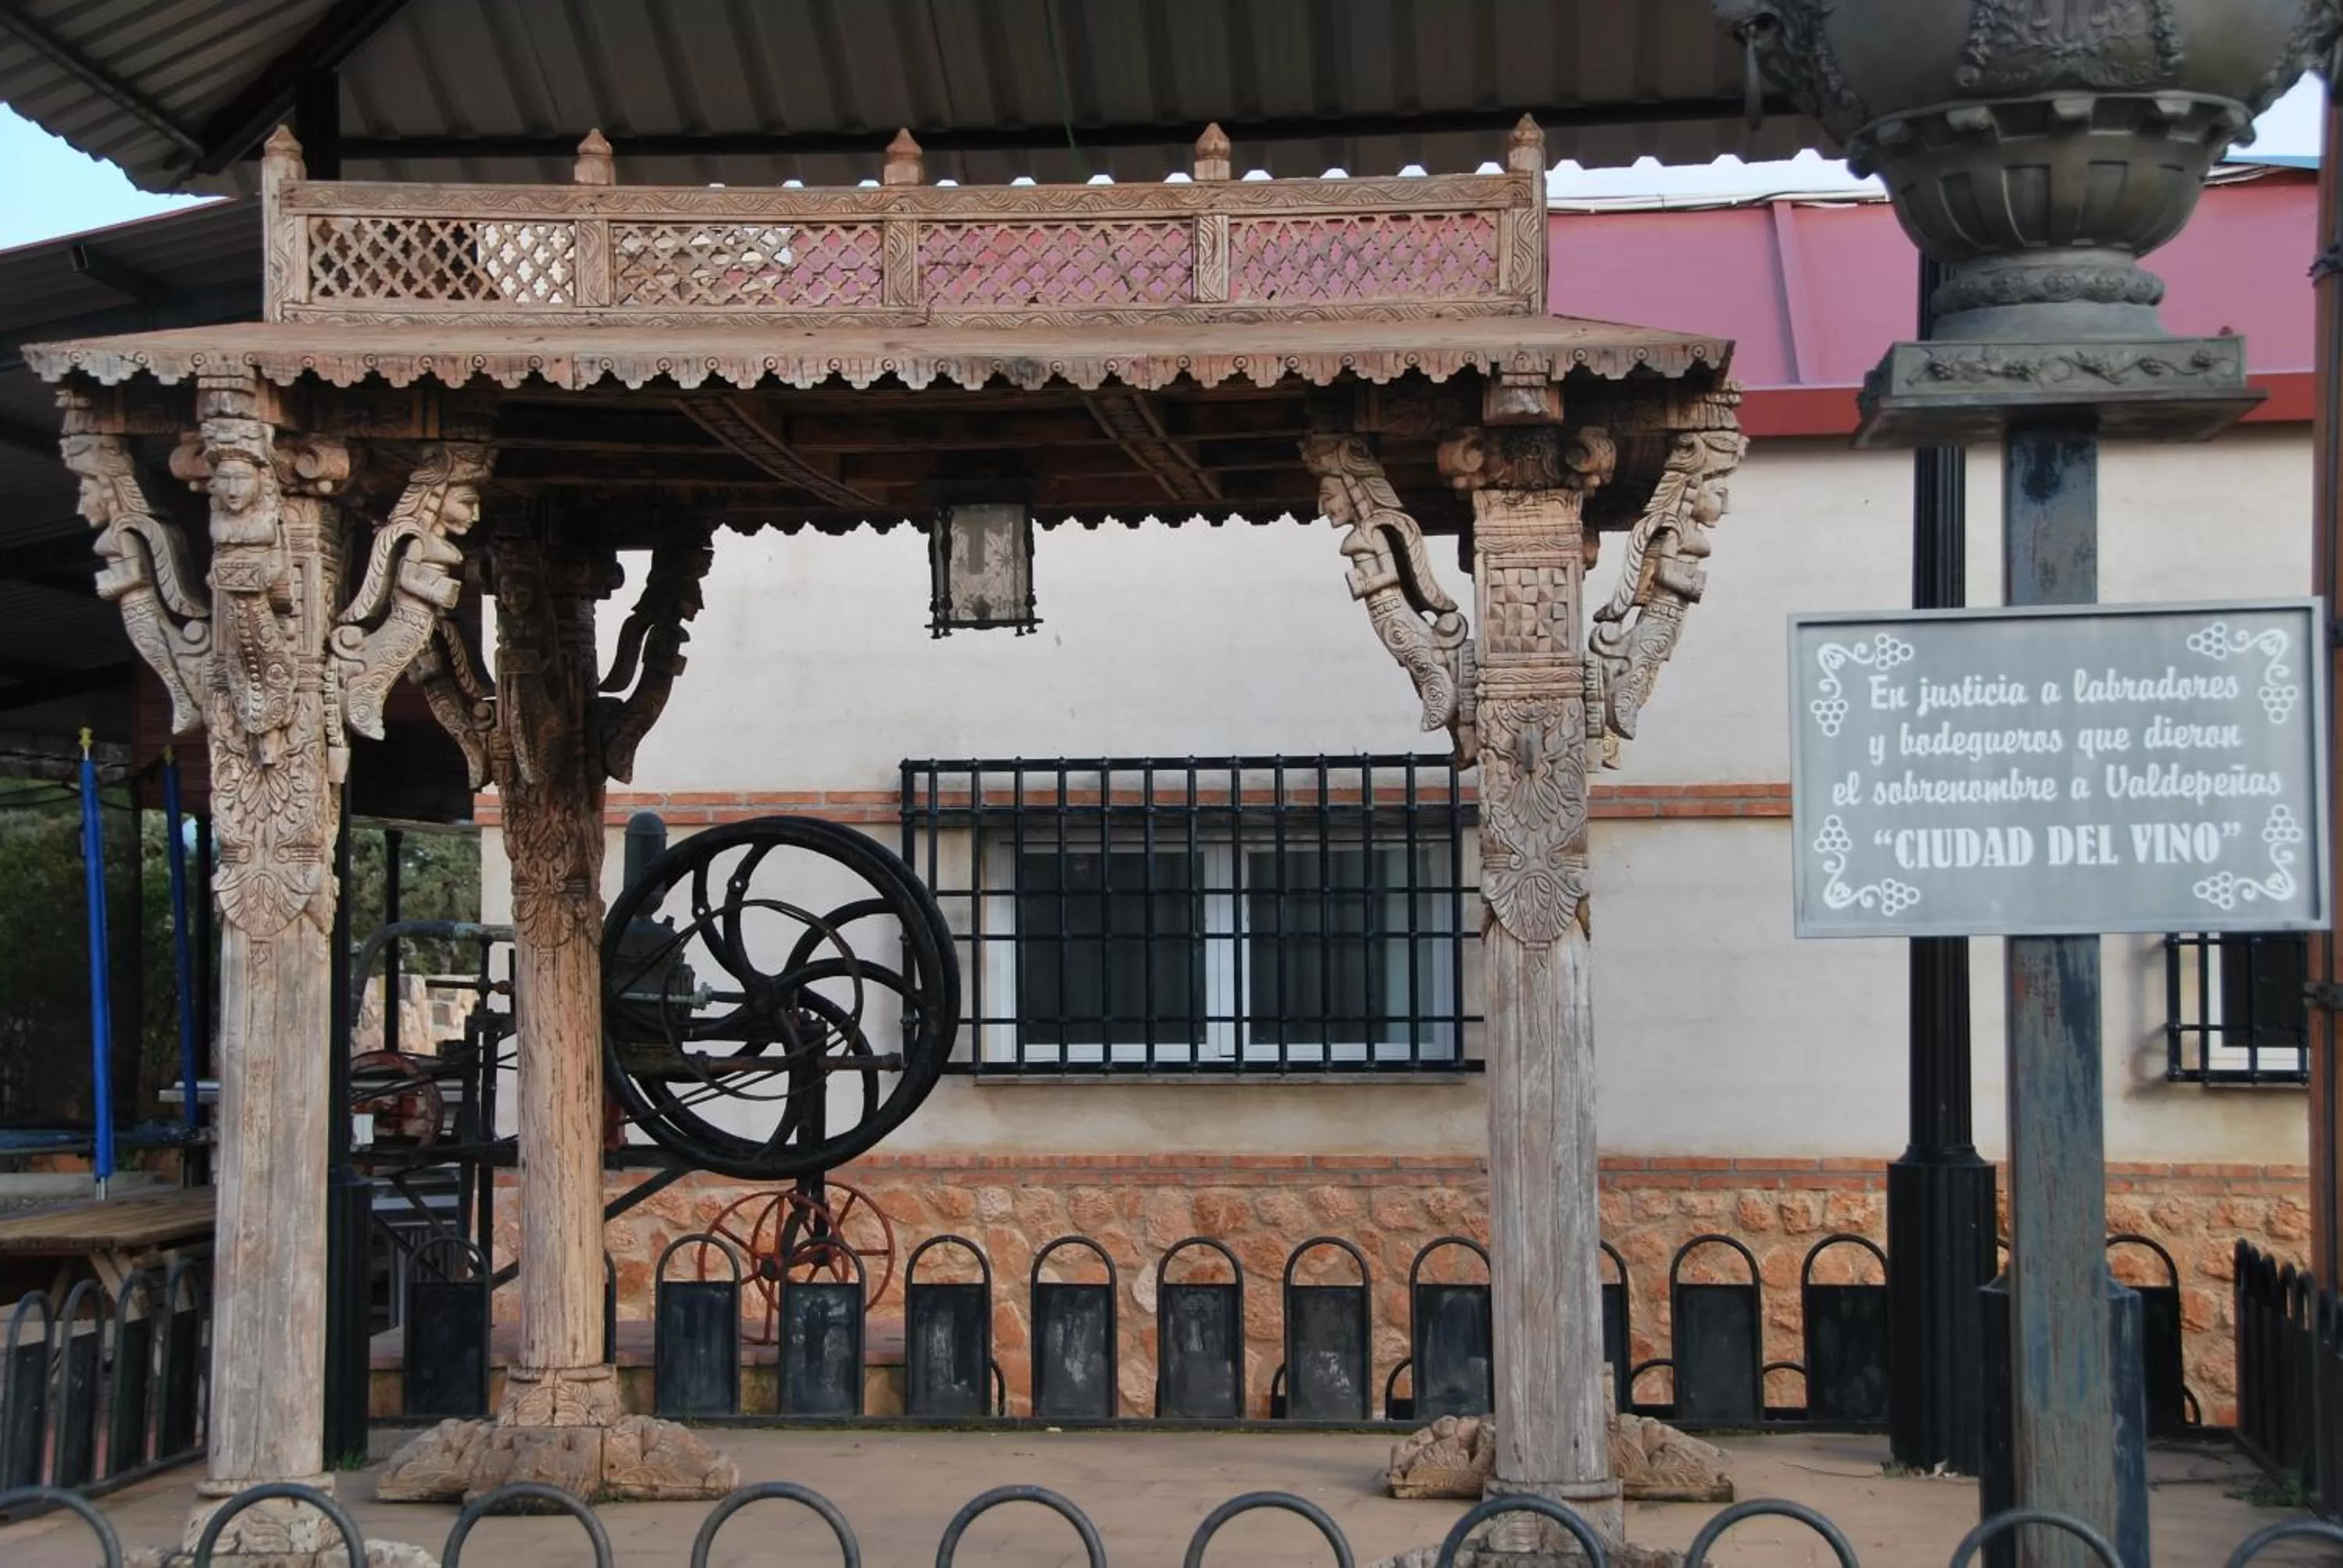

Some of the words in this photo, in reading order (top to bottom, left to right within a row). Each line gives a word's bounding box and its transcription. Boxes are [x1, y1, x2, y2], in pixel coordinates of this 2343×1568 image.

[1869, 675, 1910, 710] En
[1917, 673, 2029, 716] justicia
[2041, 682, 2061, 704] a
[2074, 667, 2240, 703] labradores
[1869, 736, 1885, 765] y
[1899, 722, 2063, 761] bodegueros
[2078, 727, 2131, 759] que
[2144, 716, 2242, 750] dieron
[1833, 772, 1861, 806] el
[1872, 770, 2058, 805] sobrenombre
[2070, 777, 2091, 800] a
[2106, 764, 2282, 804] Valdepeñas
[1874, 827, 2034, 870] “CIUDAD
[2048, 825, 2119, 866] DEL
[2131, 821, 2241, 864] VINO”
